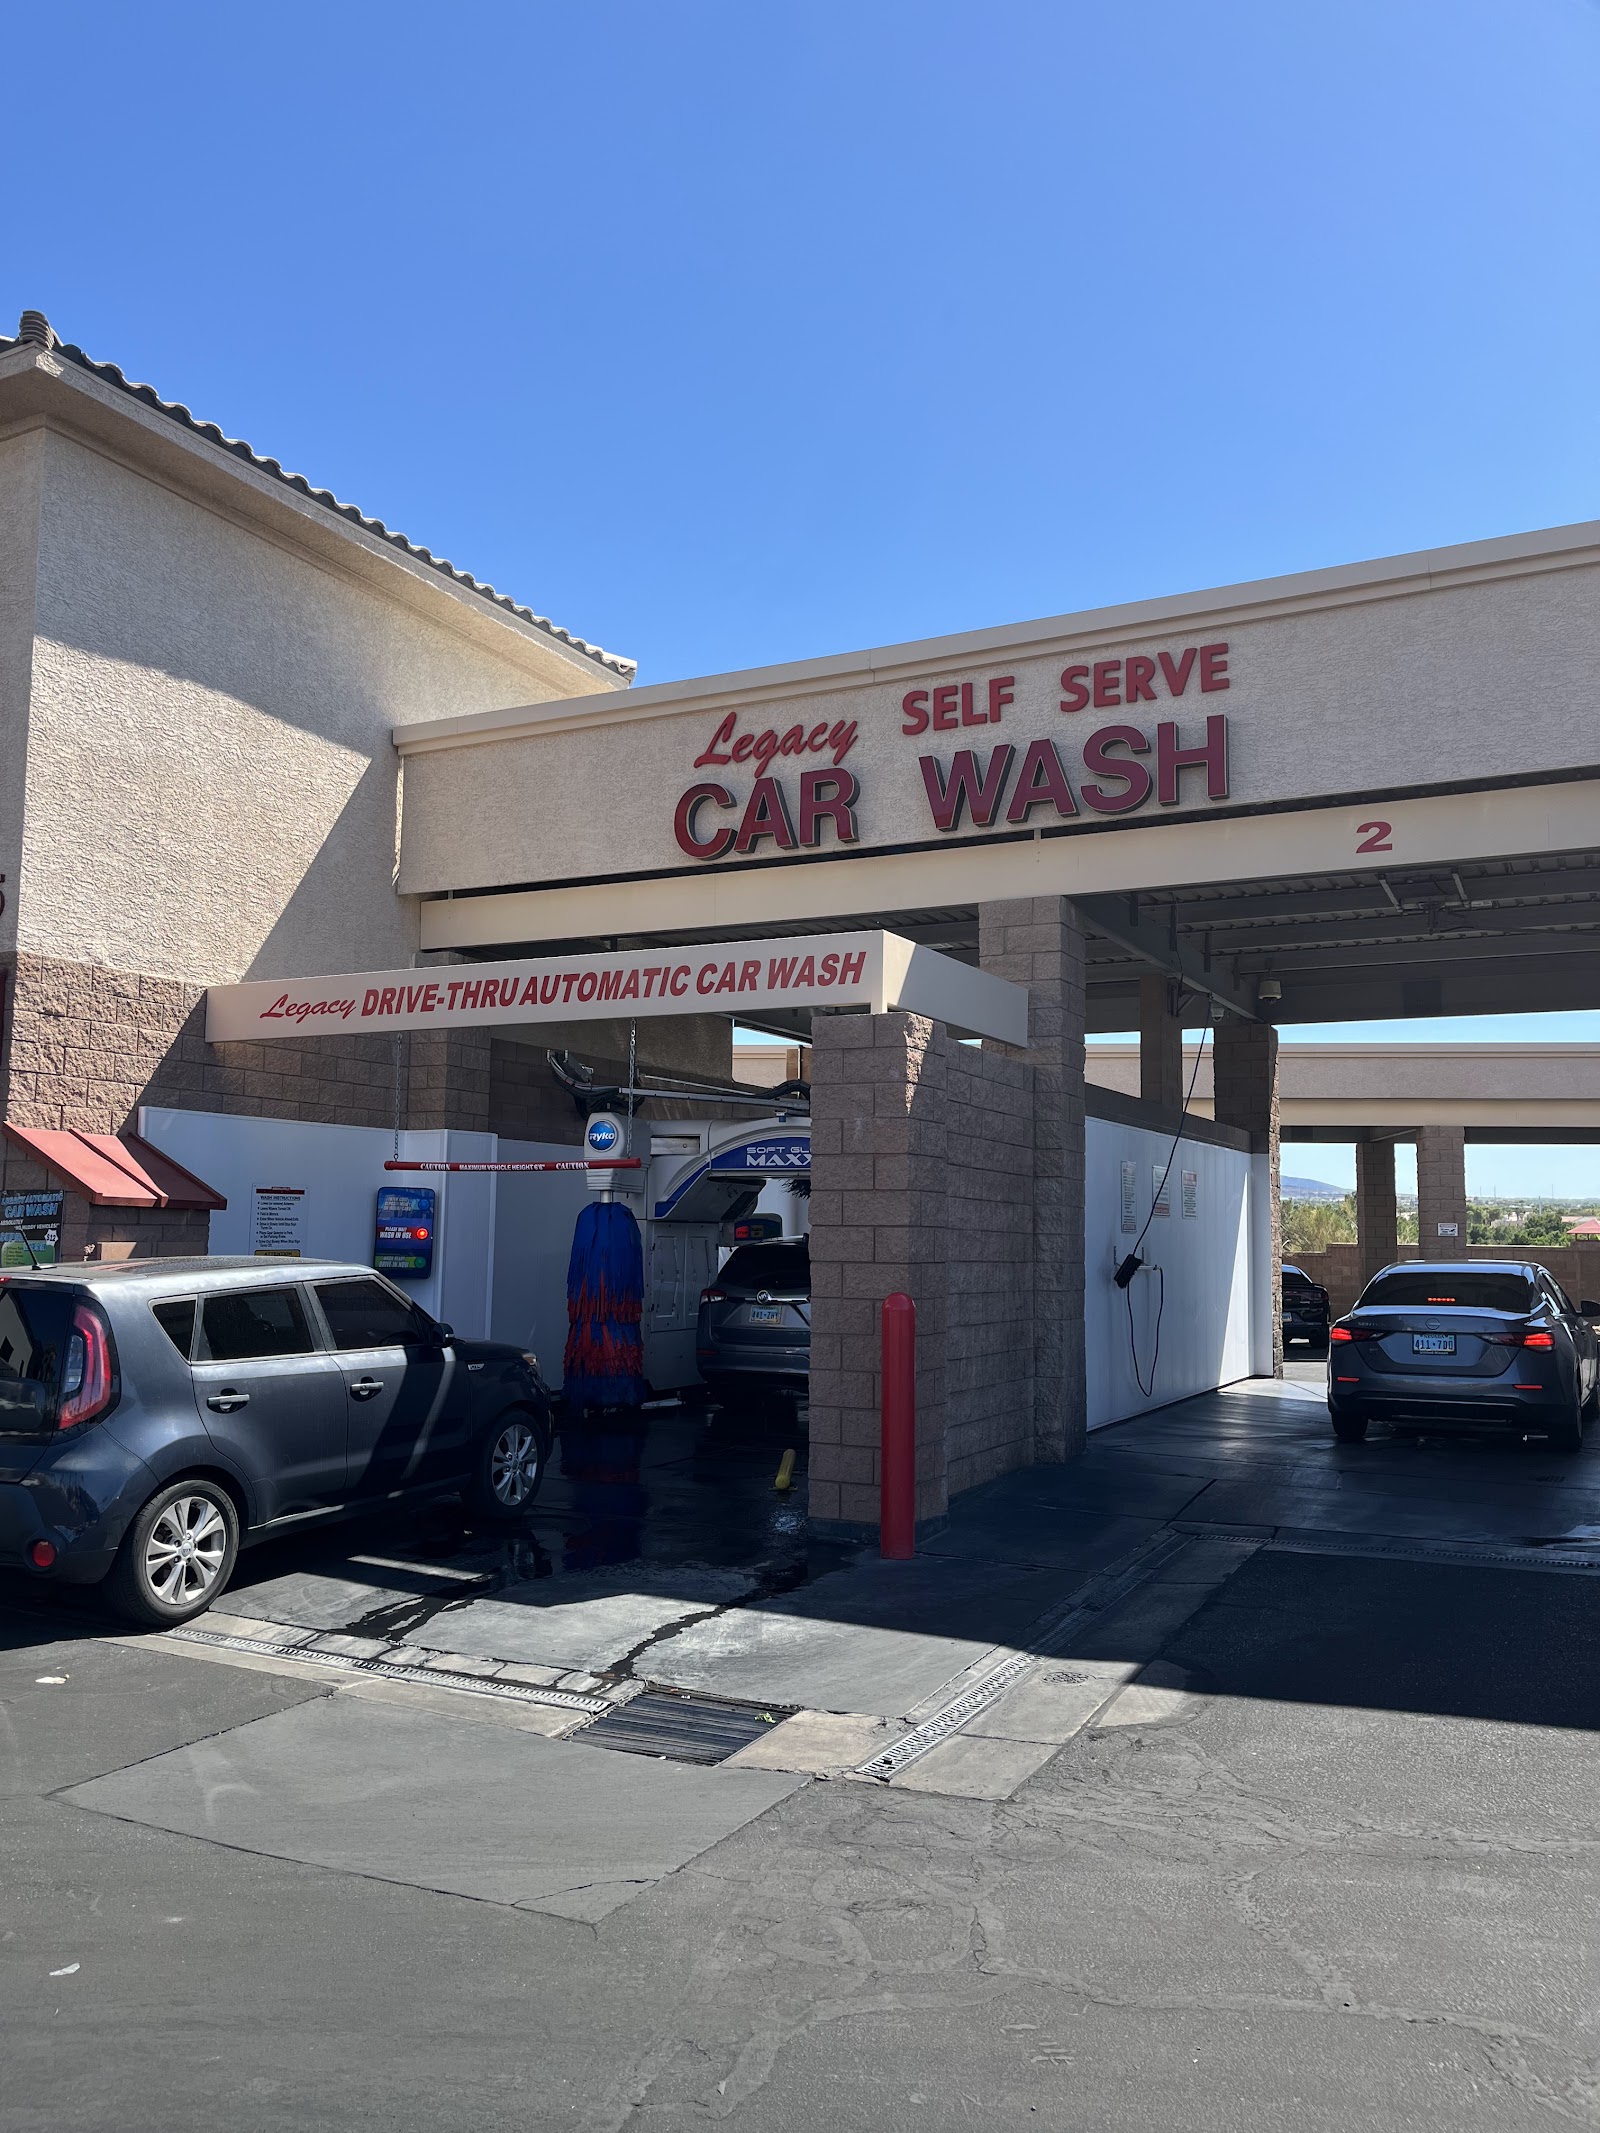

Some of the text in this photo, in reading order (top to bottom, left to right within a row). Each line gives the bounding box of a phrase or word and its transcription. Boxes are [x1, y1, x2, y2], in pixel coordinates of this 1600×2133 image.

[902, 642, 1230, 736] SELF SERVE
[693, 711, 858, 779] Legacy
[674, 714, 1229, 861] CAR WASH
[1356, 821, 1393, 854] 2
[259, 951, 867, 1024] Legacy DRIVE-THRU AUTOMATIC CAR WASH
[746, 1146, 786, 1154] SOFT
[420, 1163, 451, 1171] CAUTION
[556, 1162, 590, 1170] CAUTION
[25, 1193, 63, 1204] AUTOMATIC
[5, 1202, 59, 1218] CAR WASH
[46, 1233, 57, 1241] $12
[380, 1231, 412, 1239] WASH IN USE
